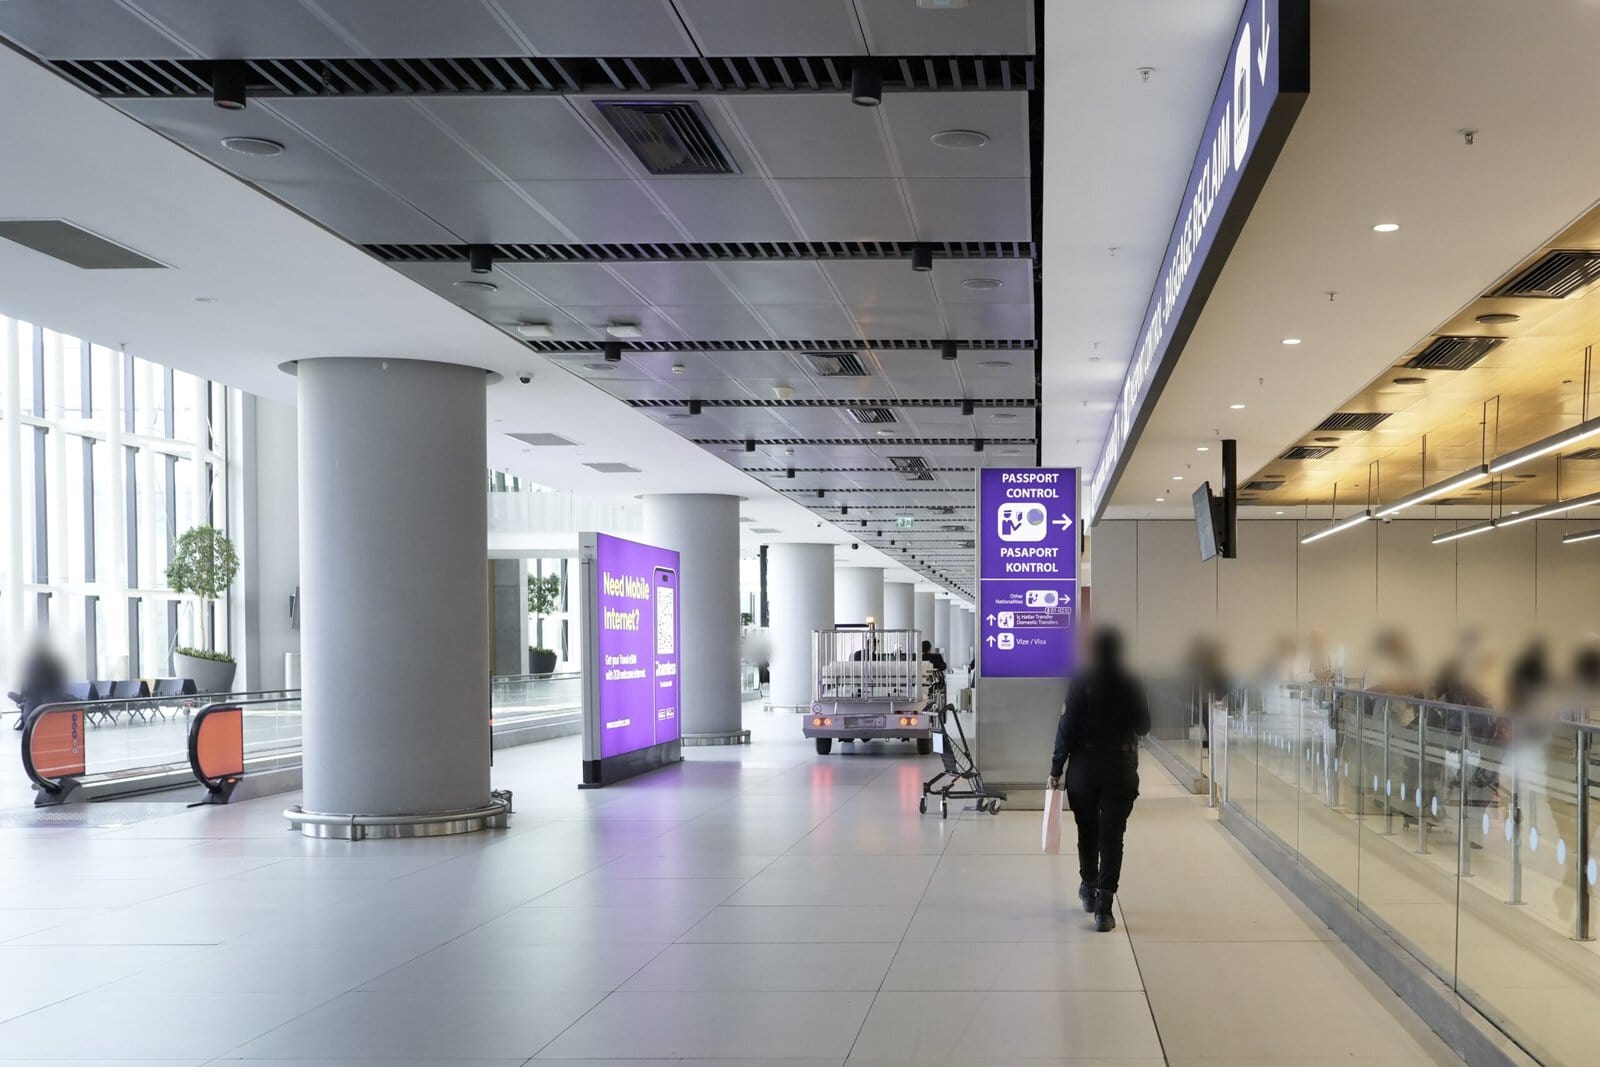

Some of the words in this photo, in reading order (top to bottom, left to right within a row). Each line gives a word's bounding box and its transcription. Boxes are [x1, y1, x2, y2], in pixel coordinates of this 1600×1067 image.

[1165, 206, 1193, 324] BAGGAGE
[1192, 99, 1231, 254] RECLAIM
[1002, 473, 1059, 483] PASSPORT
[1006, 488, 1059, 498] CONTROL
[1000, 548, 1059, 557] PASAPORT
[1005, 563, 1059, 572] KONTROL
[603, 571, 624, 597] Need
[625, 575, 649, 600] Mobile
[604, 605, 640, 631] Internet?
